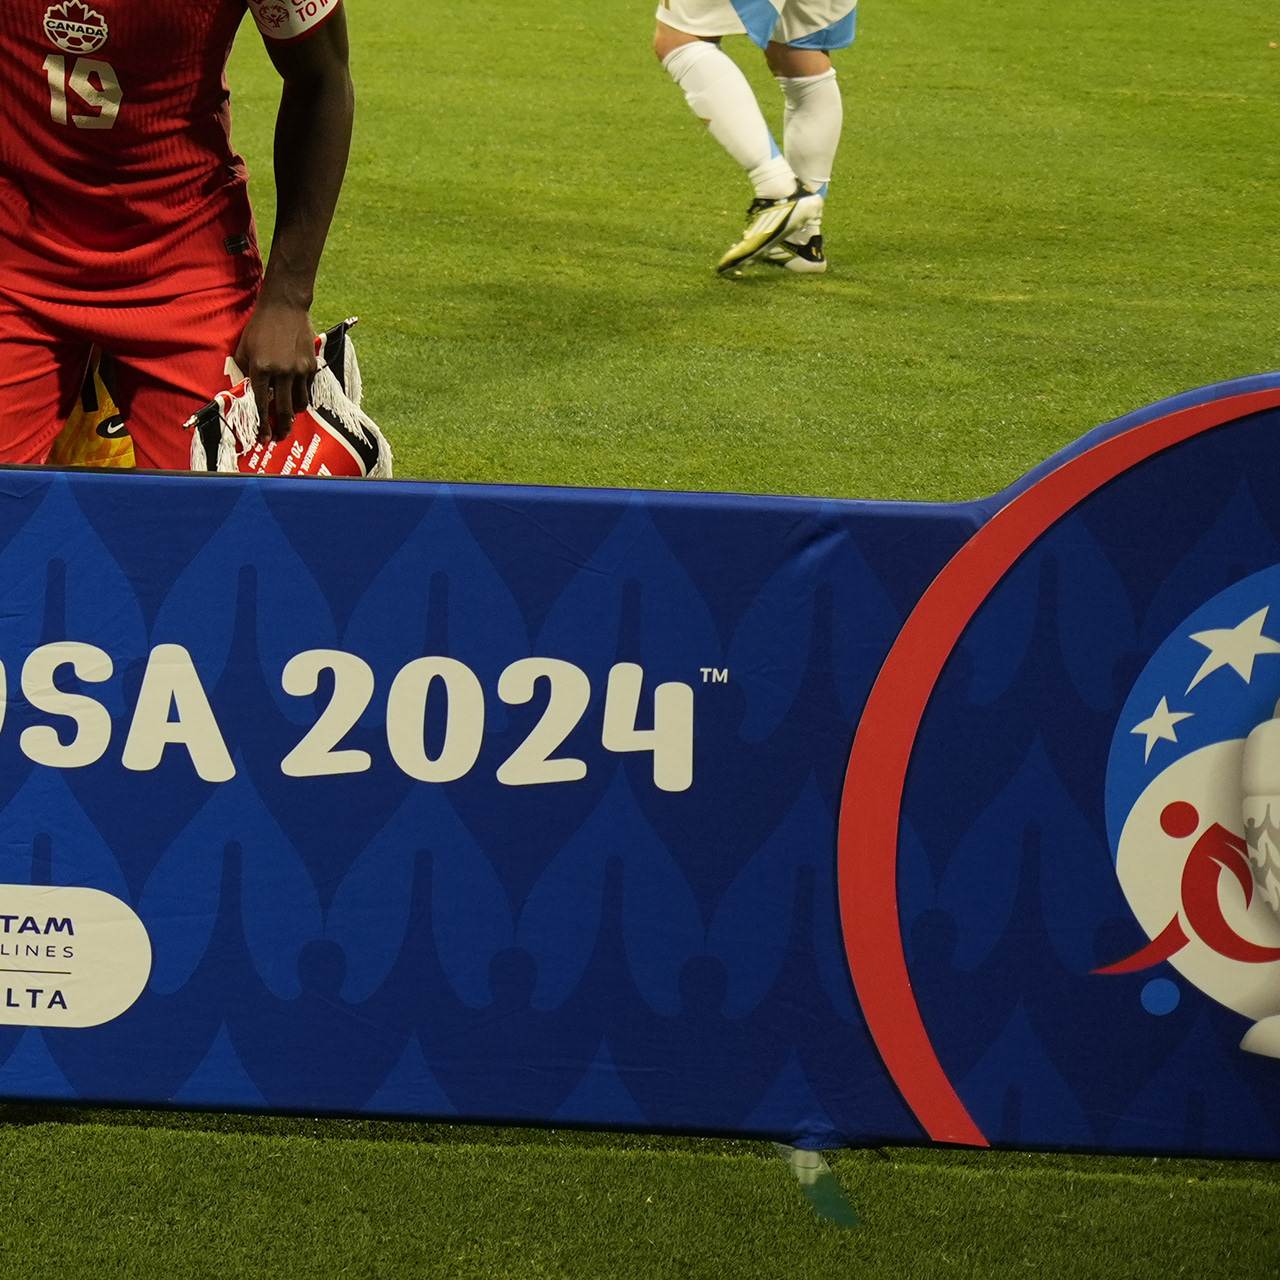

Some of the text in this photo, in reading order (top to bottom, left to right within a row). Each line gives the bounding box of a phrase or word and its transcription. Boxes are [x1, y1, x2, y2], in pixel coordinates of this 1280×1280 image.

[295, 1, 318, 23] TO
[45, 19, 105, 37] CANADA
[42, 53, 124, 130] 19
[290, 440, 304, 459] 20
